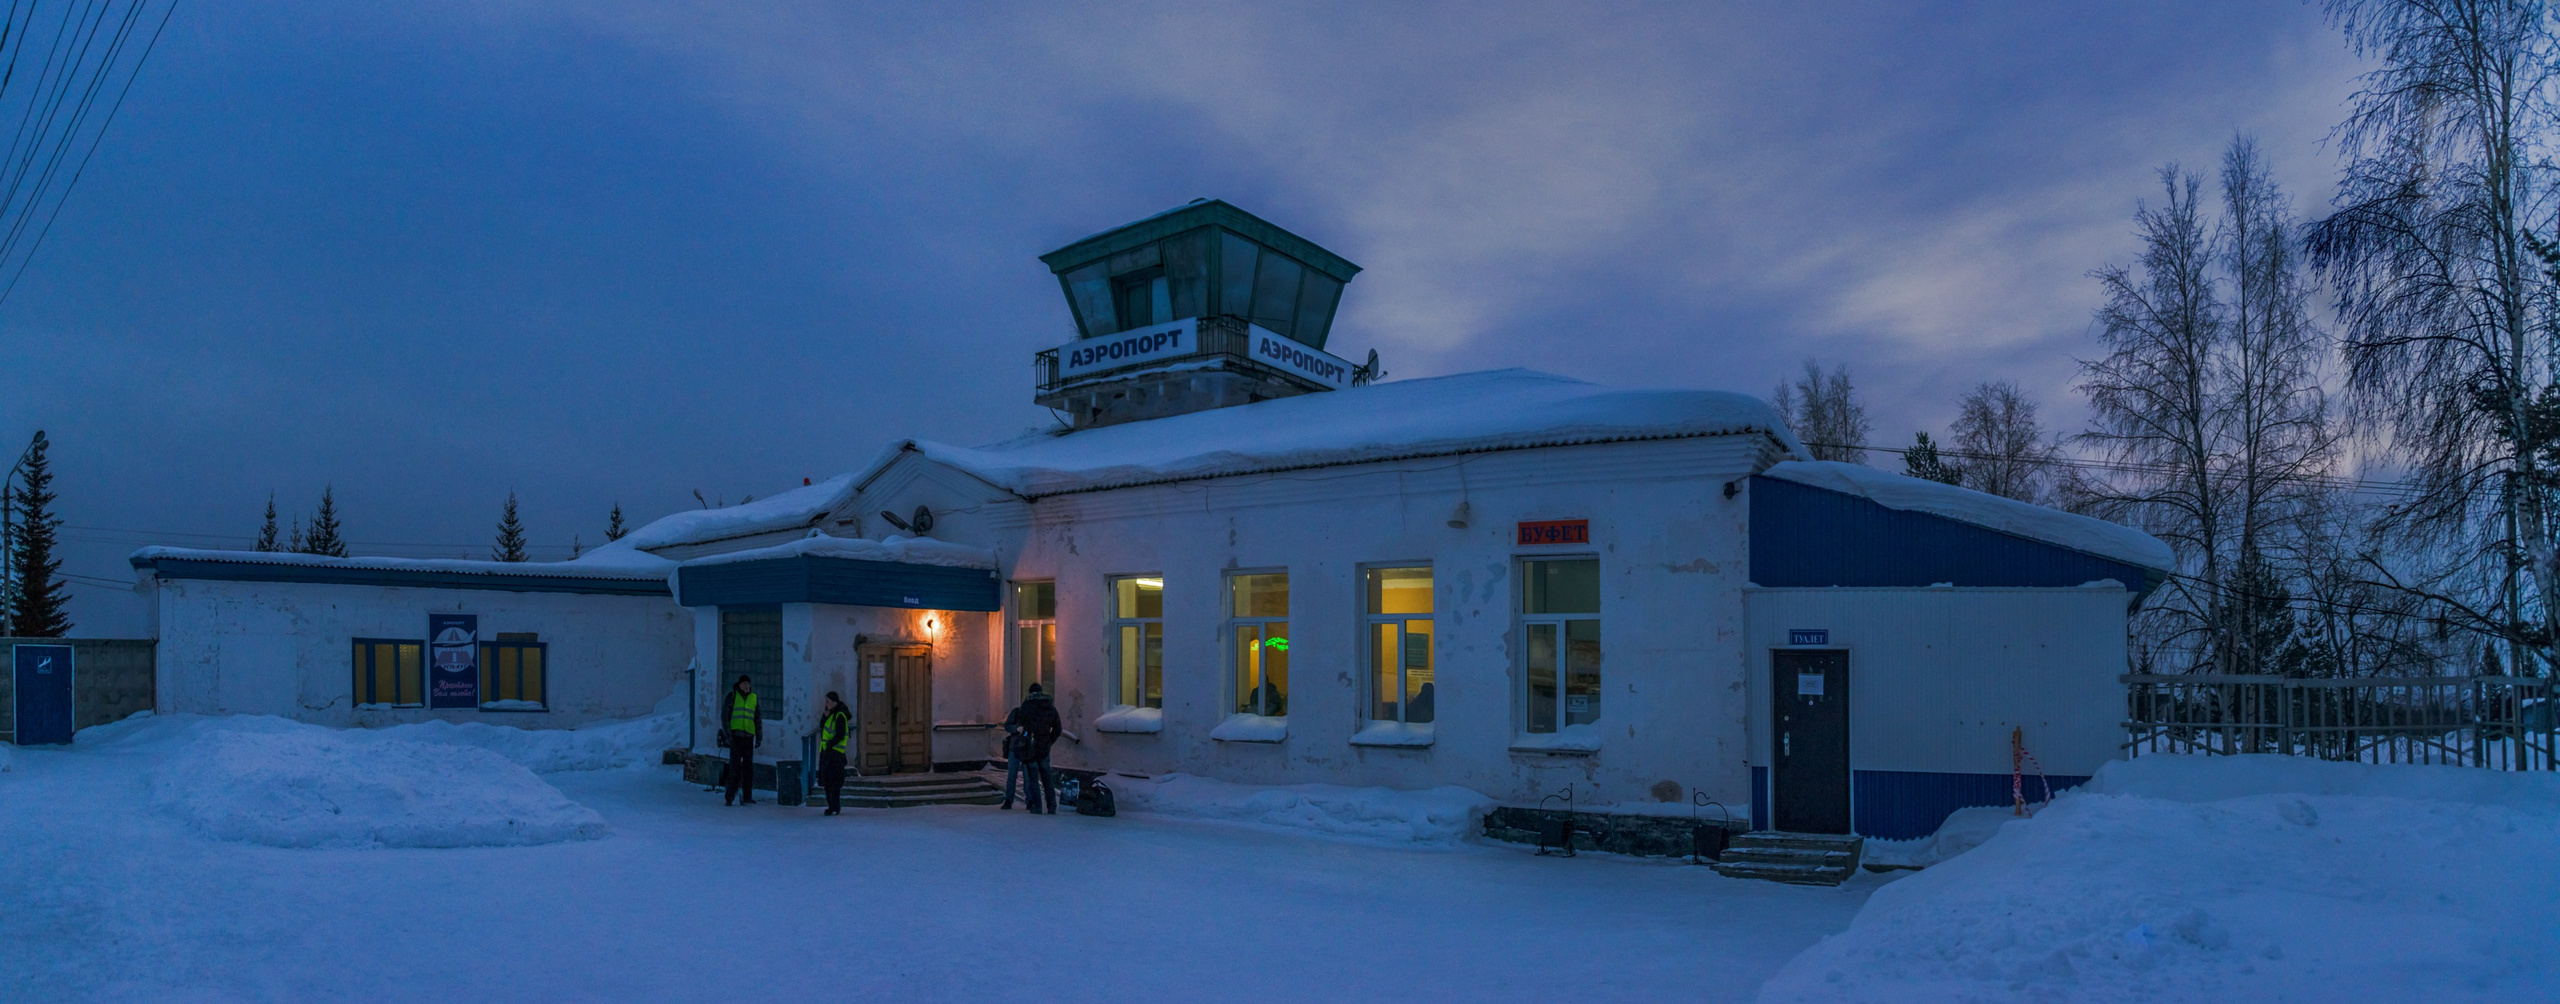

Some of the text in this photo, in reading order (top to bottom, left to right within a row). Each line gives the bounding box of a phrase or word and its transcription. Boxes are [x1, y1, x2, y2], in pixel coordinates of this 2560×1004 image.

[1069, 329, 1183, 368] АЭРОПОРТ
[1259, 337, 1345, 383] АЭРОПОРТ
[1521, 525, 1586, 542] БУФЕТ
[1794, 634, 1824, 643] ТУАЛЕТ
